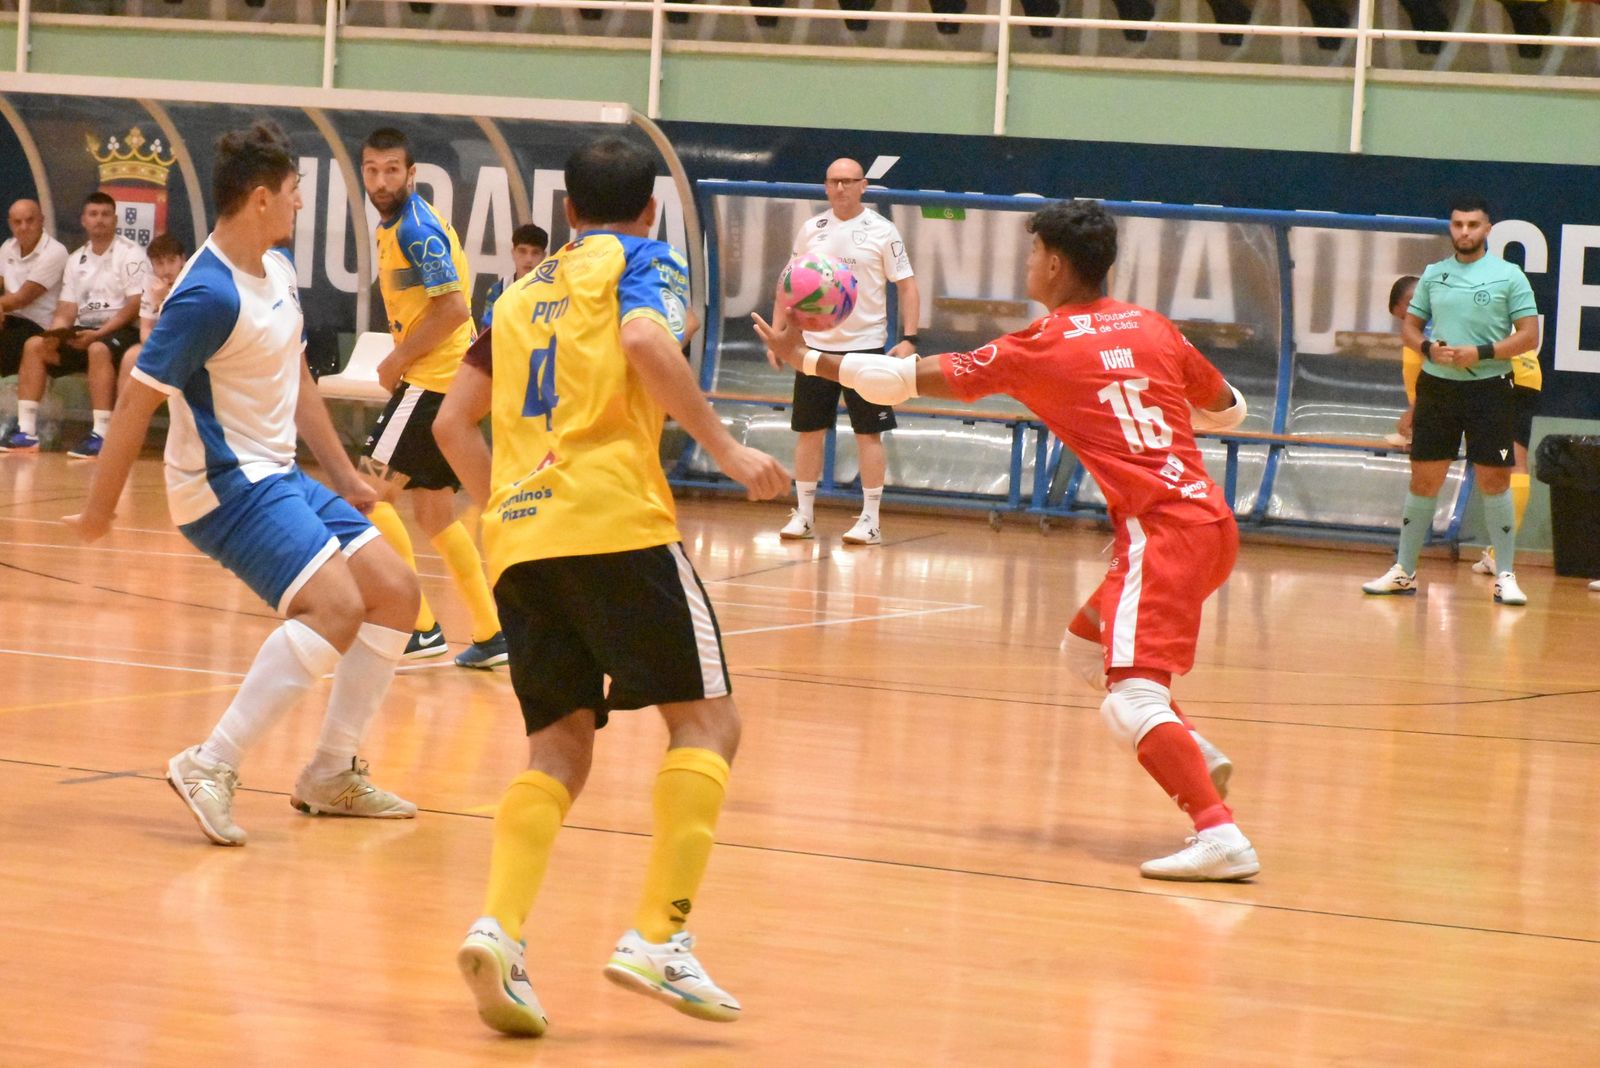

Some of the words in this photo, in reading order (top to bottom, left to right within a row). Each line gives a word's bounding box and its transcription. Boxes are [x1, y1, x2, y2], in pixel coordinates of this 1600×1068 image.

[1094, 309, 1142, 322] Diputación
[1099, 325, 1112, 333] de
[1113, 320, 1139, 331] Cádiz
[521, 333, 560, 431] 4
[1097, 377, 1173, 454] 16
[497, 486, 553, 514] omino's
[502, 506, 537, 523] Pizza
